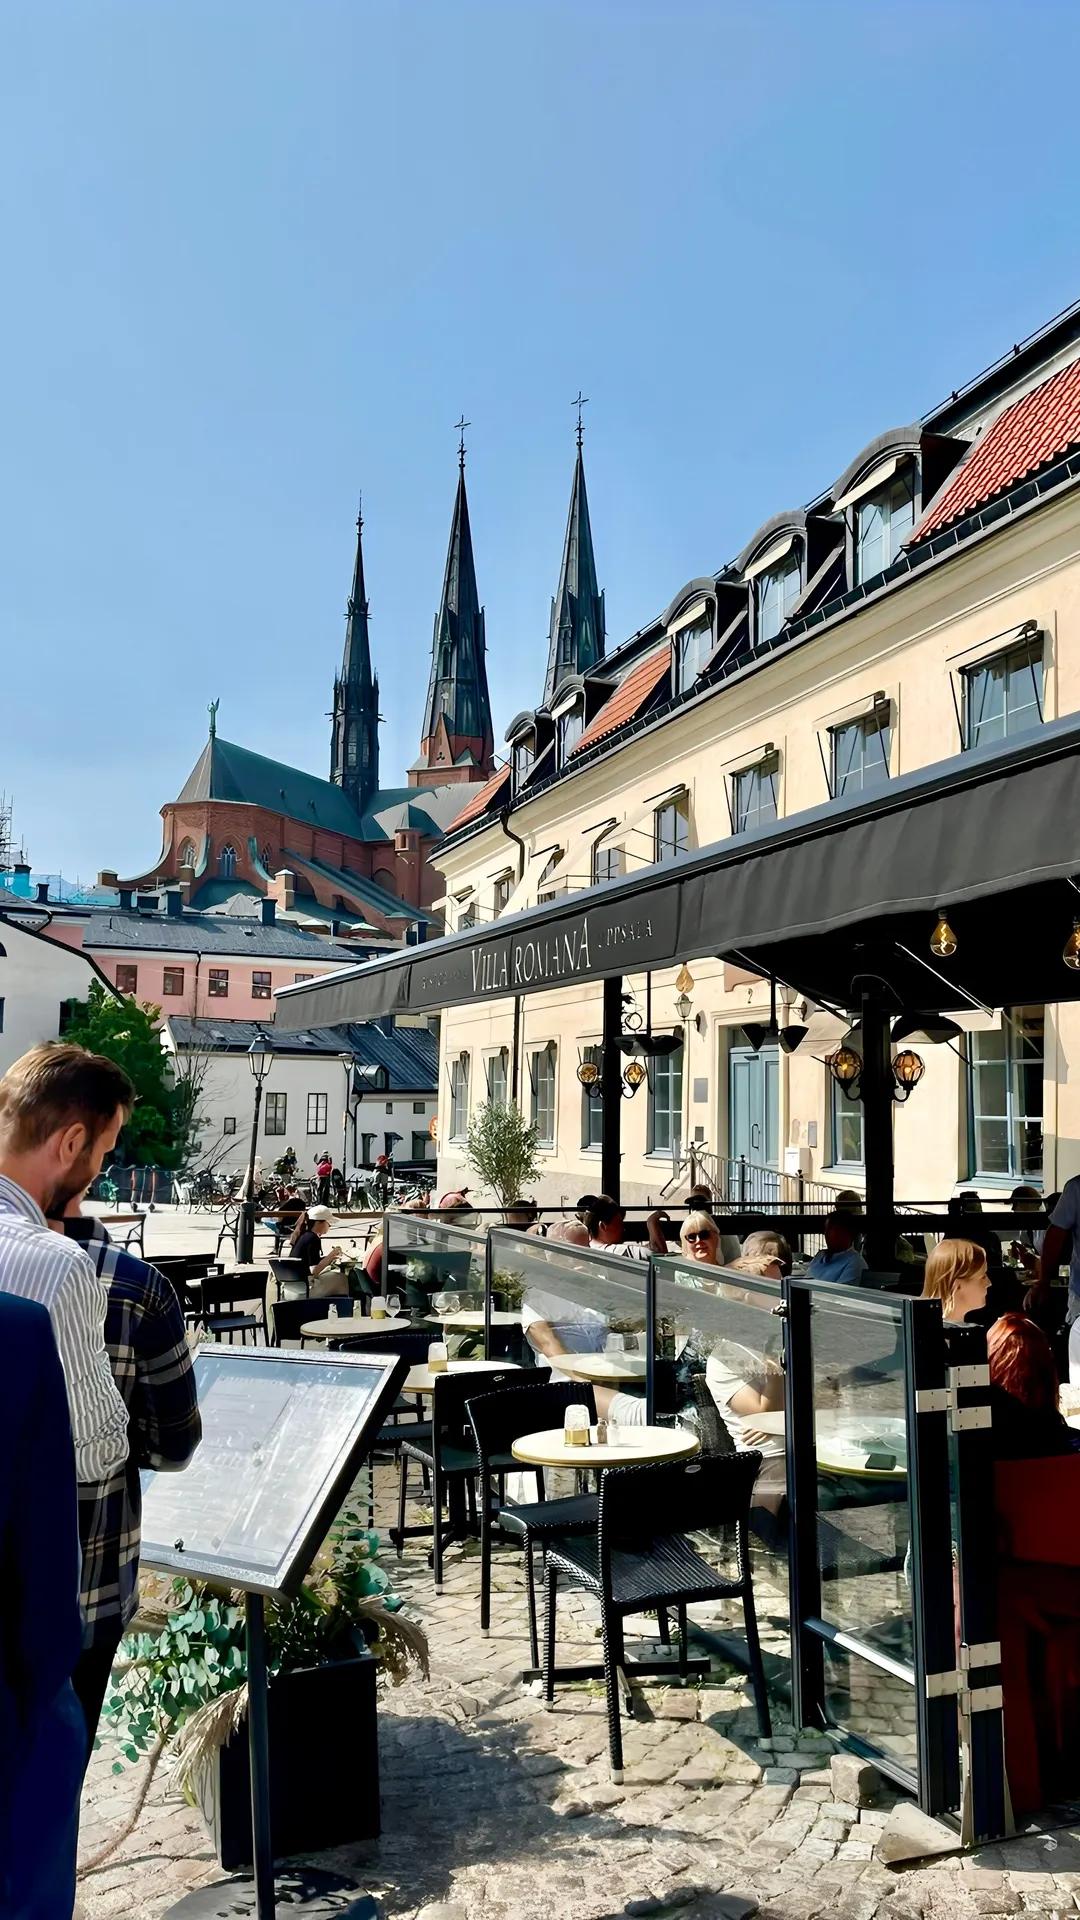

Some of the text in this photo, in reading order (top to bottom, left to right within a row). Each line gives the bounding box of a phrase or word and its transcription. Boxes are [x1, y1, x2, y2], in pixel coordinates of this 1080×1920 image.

[472, 947, 508, 992] VILLA
[514, 917, 592, 983] ROMANA
[597, 919, 653, 948] PPSALA
